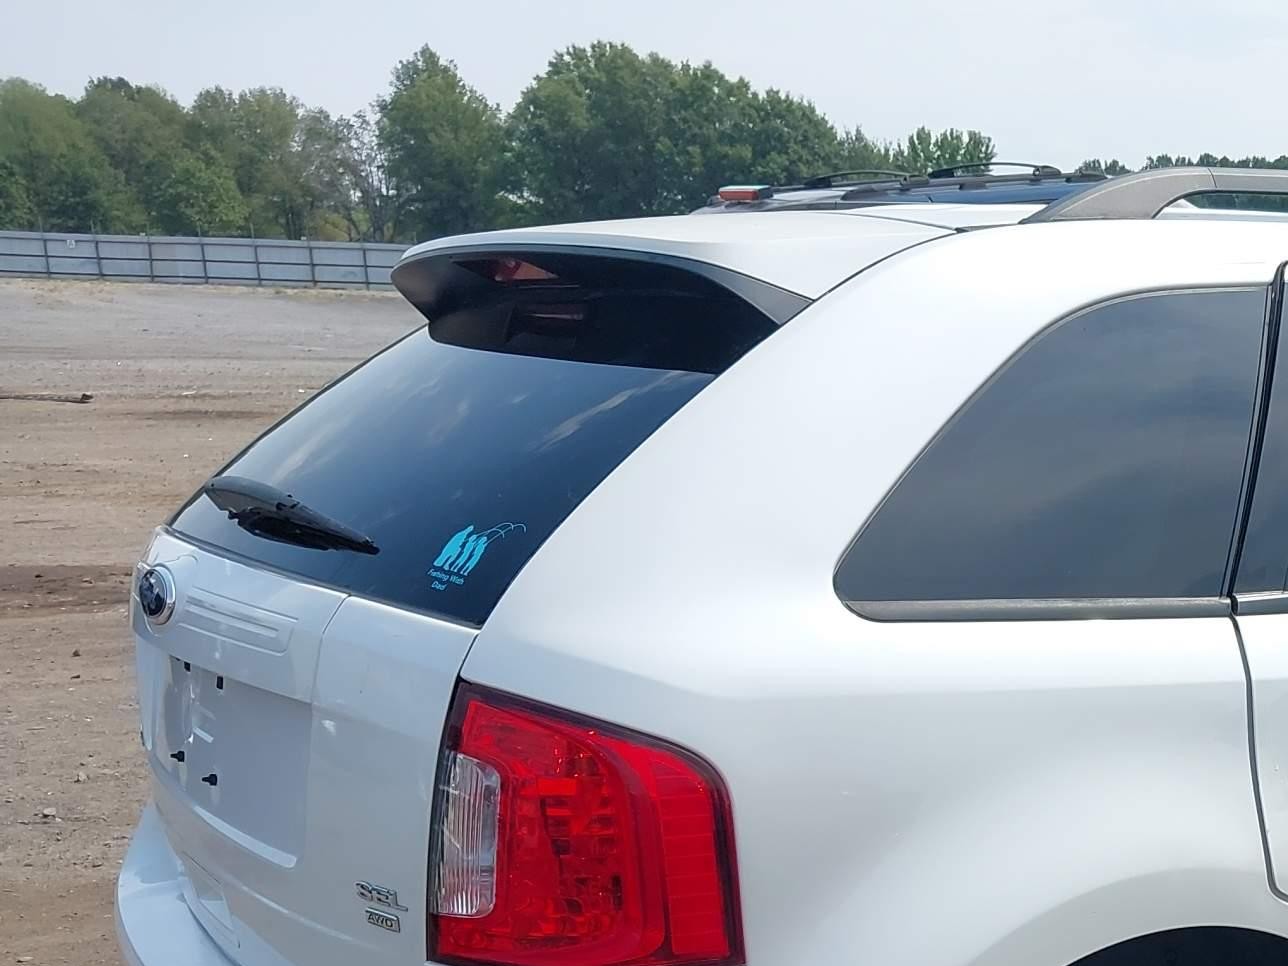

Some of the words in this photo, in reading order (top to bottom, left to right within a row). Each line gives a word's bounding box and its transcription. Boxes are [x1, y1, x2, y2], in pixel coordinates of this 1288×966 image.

[431, 580, 448, 591] Dad
[353, 880, 408, 912] SEL
[368, 913, 394, 928] AWD
